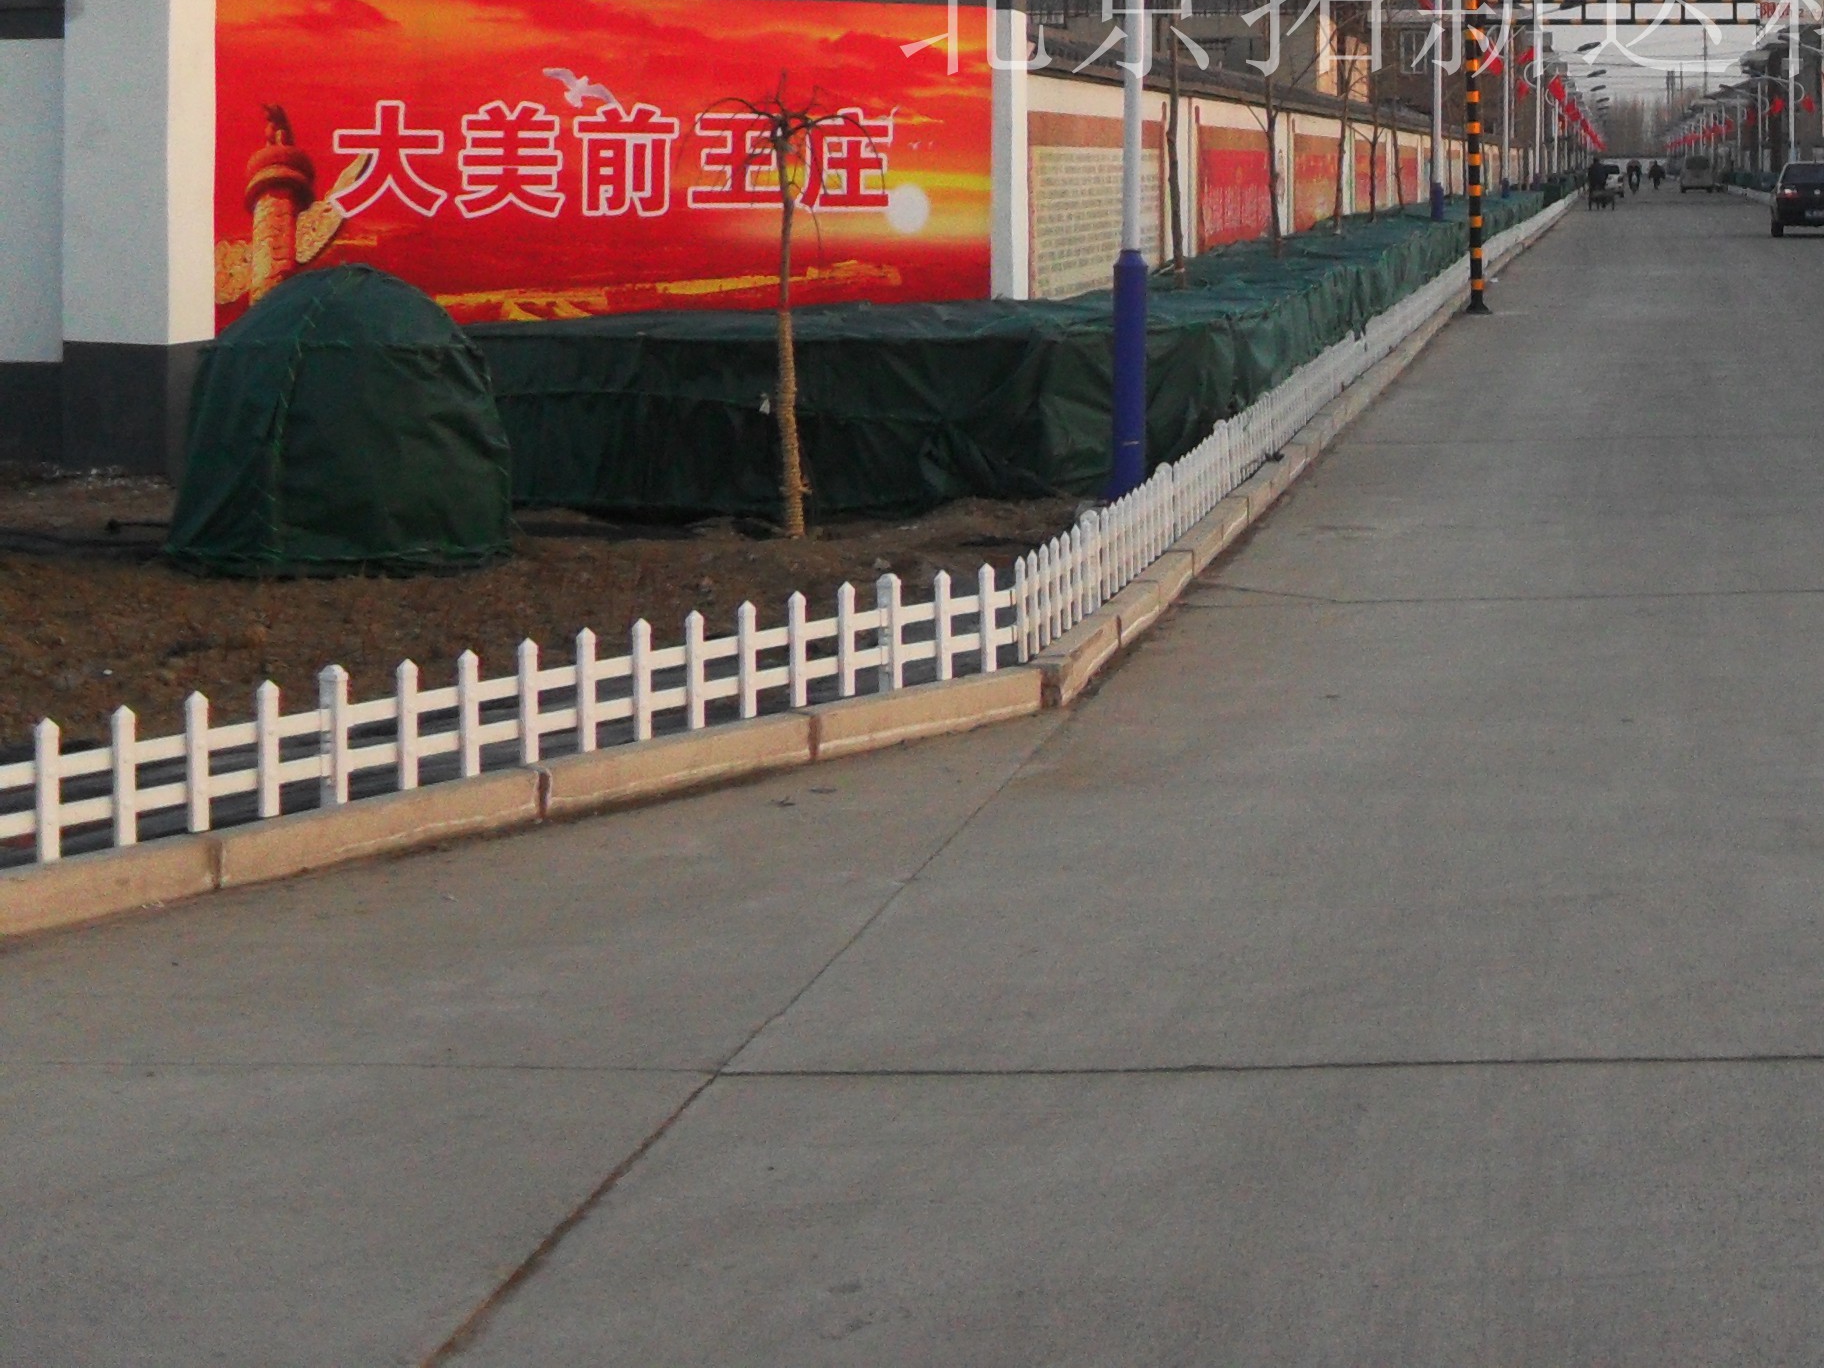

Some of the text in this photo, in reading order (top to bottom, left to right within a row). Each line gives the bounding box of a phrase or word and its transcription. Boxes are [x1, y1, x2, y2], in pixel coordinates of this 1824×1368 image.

[328, 100, 894, 219] 大美前王庄
